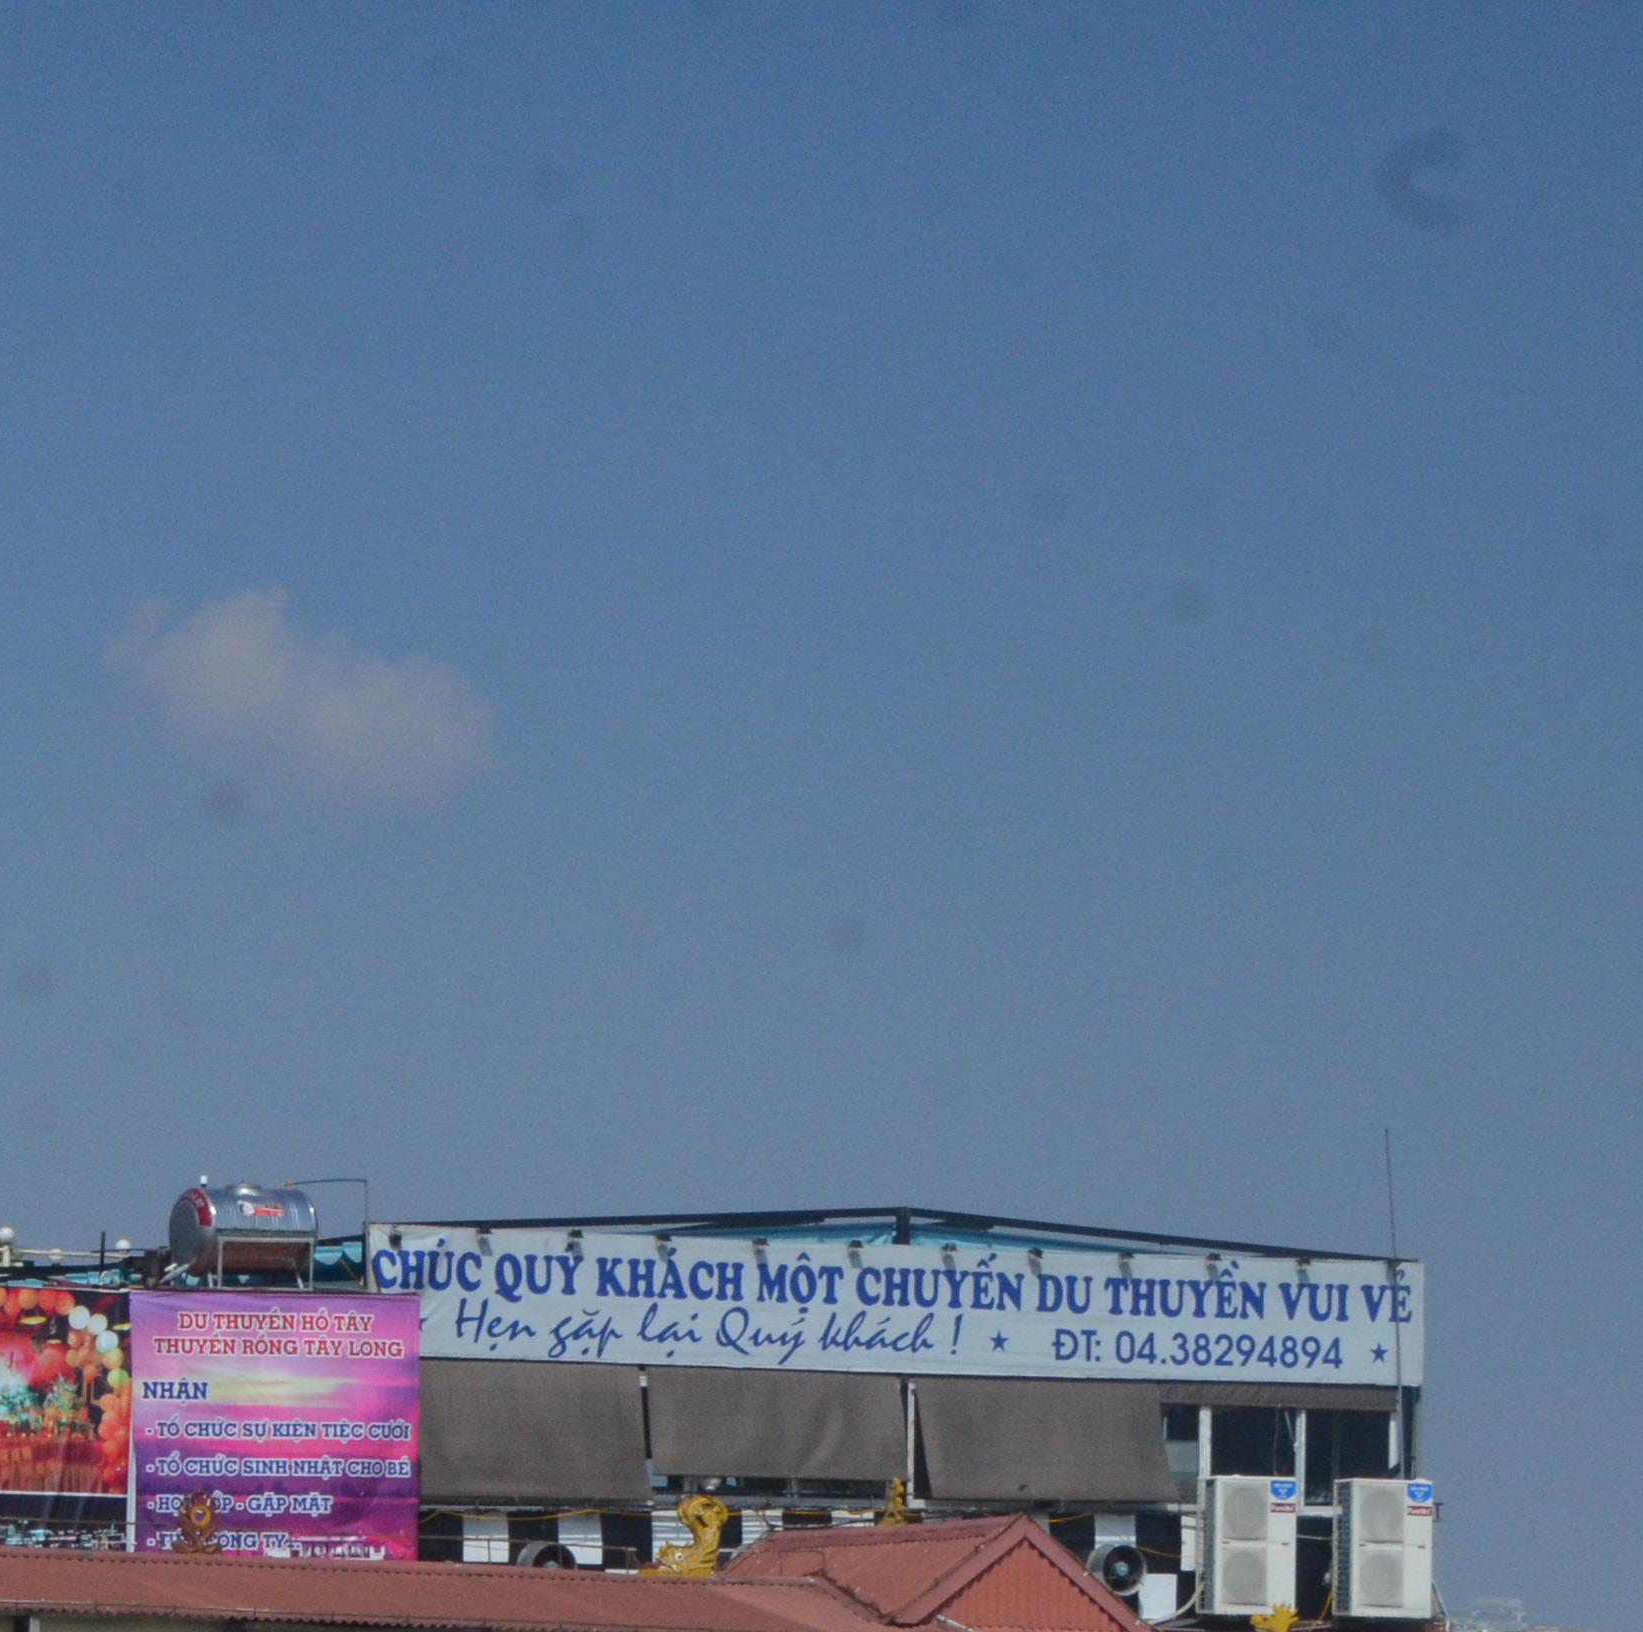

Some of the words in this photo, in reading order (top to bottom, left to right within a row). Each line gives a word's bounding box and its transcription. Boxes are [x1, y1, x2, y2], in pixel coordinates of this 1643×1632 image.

[372, 1239, 482, 1292] CHÚC
[595, 1246, 744, 1302] KHÁCH
[757, 1252, 843, 1315] MỘT
[856, 1253, 1025, 1312] CHUYẾN
[1036, 1273, 1093, 1314] DU
[1104, 1260, 1267, 1320] THUYỀN
[1278, 1282, 1349, 1323] VUI
[178, 1312, 208, 1330] DU
[455, 1298, 536, 1351] Hẹn
[547, 1309, 623, 1359] gặp
[636, 1302, 702, 1358] lại
[716, 1306, 807, 1365] Quý
[818, 1310, 935, 1354] khách
[347, 1338, 404, 1358] LONG
[1051, 1328, 1101, 1362] ĐT:
[1115, 1331, 1343, 1369] 04.38294894
[142, 1377, 209, 1405] NHẬN
[241, 1457, 289, 1476] SINH
[292, 1456, 344, 1480] NHẬT
[346, 1459, 384, 1477] CHO
